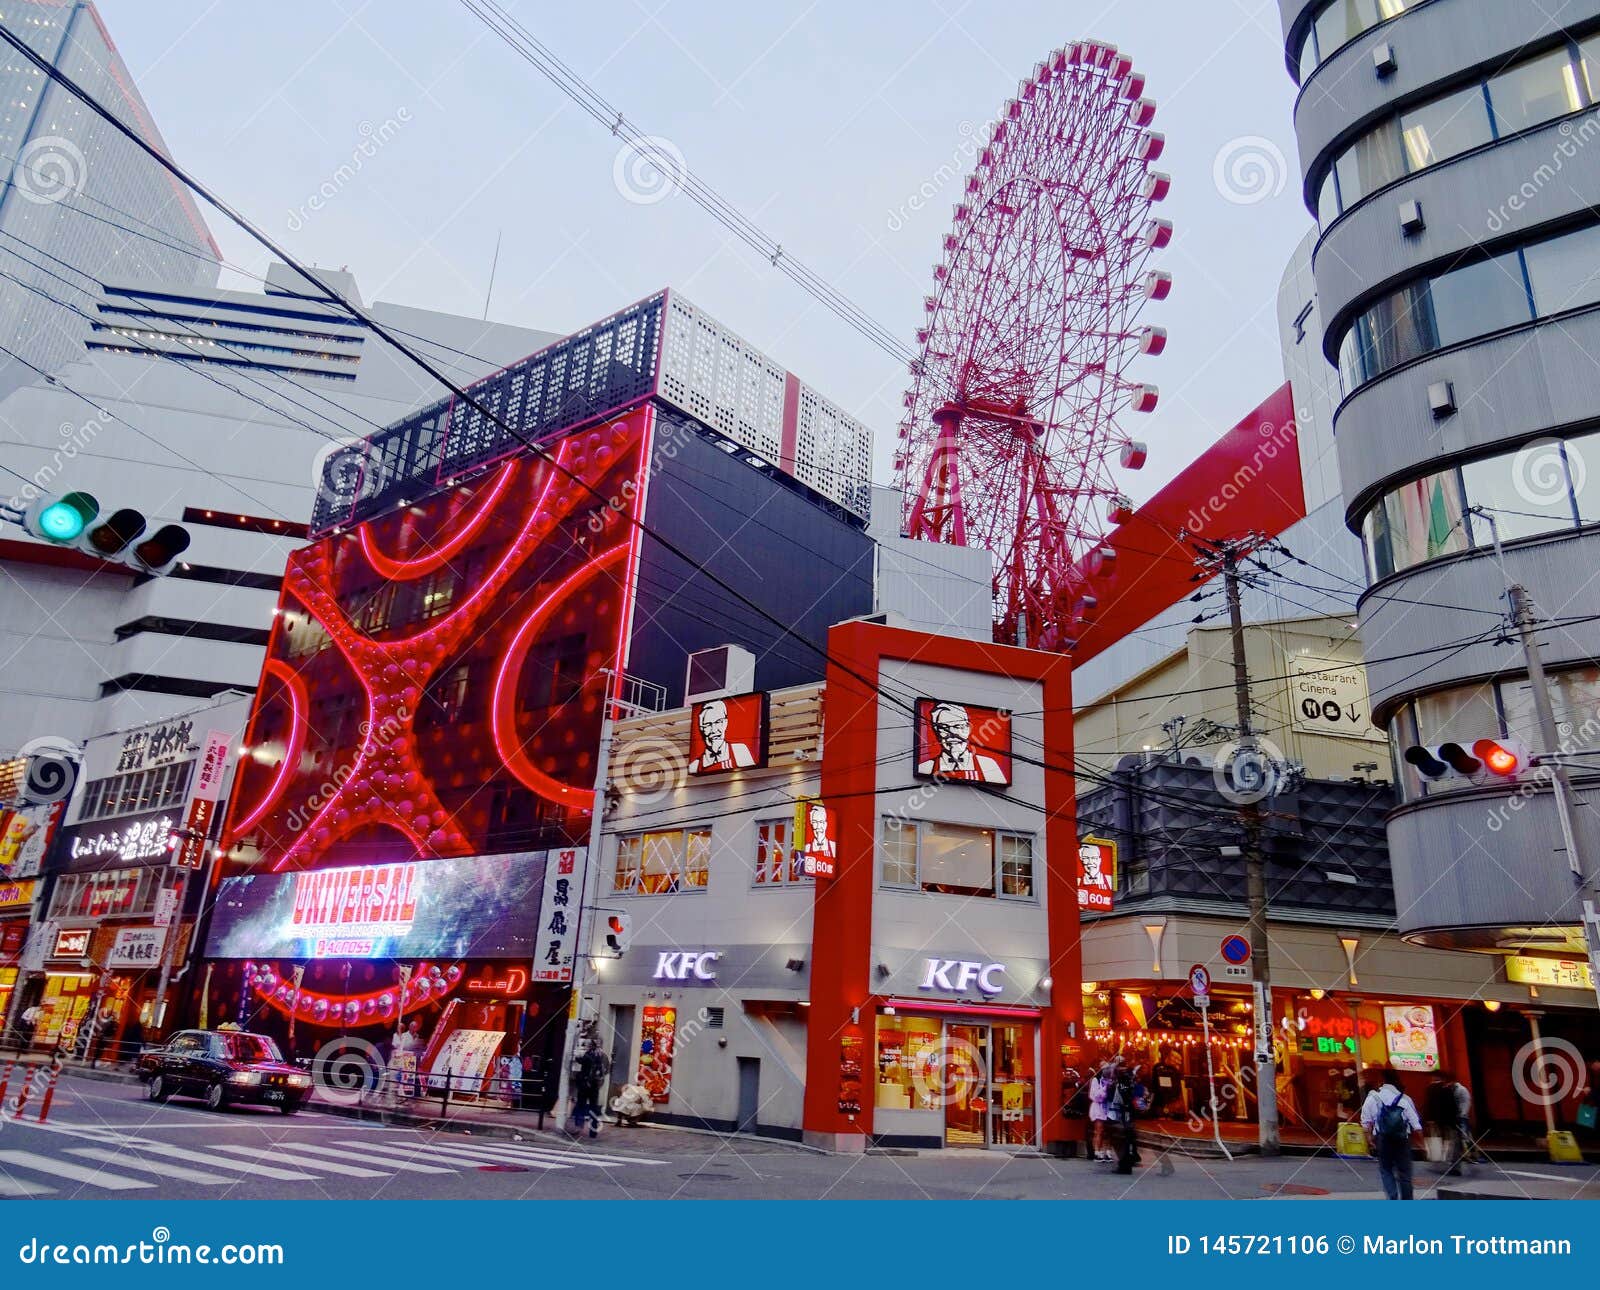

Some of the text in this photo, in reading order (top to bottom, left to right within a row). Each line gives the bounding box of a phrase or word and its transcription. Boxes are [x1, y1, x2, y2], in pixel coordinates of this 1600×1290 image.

[1298, 667, 1359, 685] Restaurant
[1300, 682, 1337, 696] Cinema
[293, 864, 417, 925] UNIVERSAL
[653, 951, 718, 980] KFC
[918, 957, 1007, 994] KFC
[505, 969, 526, 994] D
